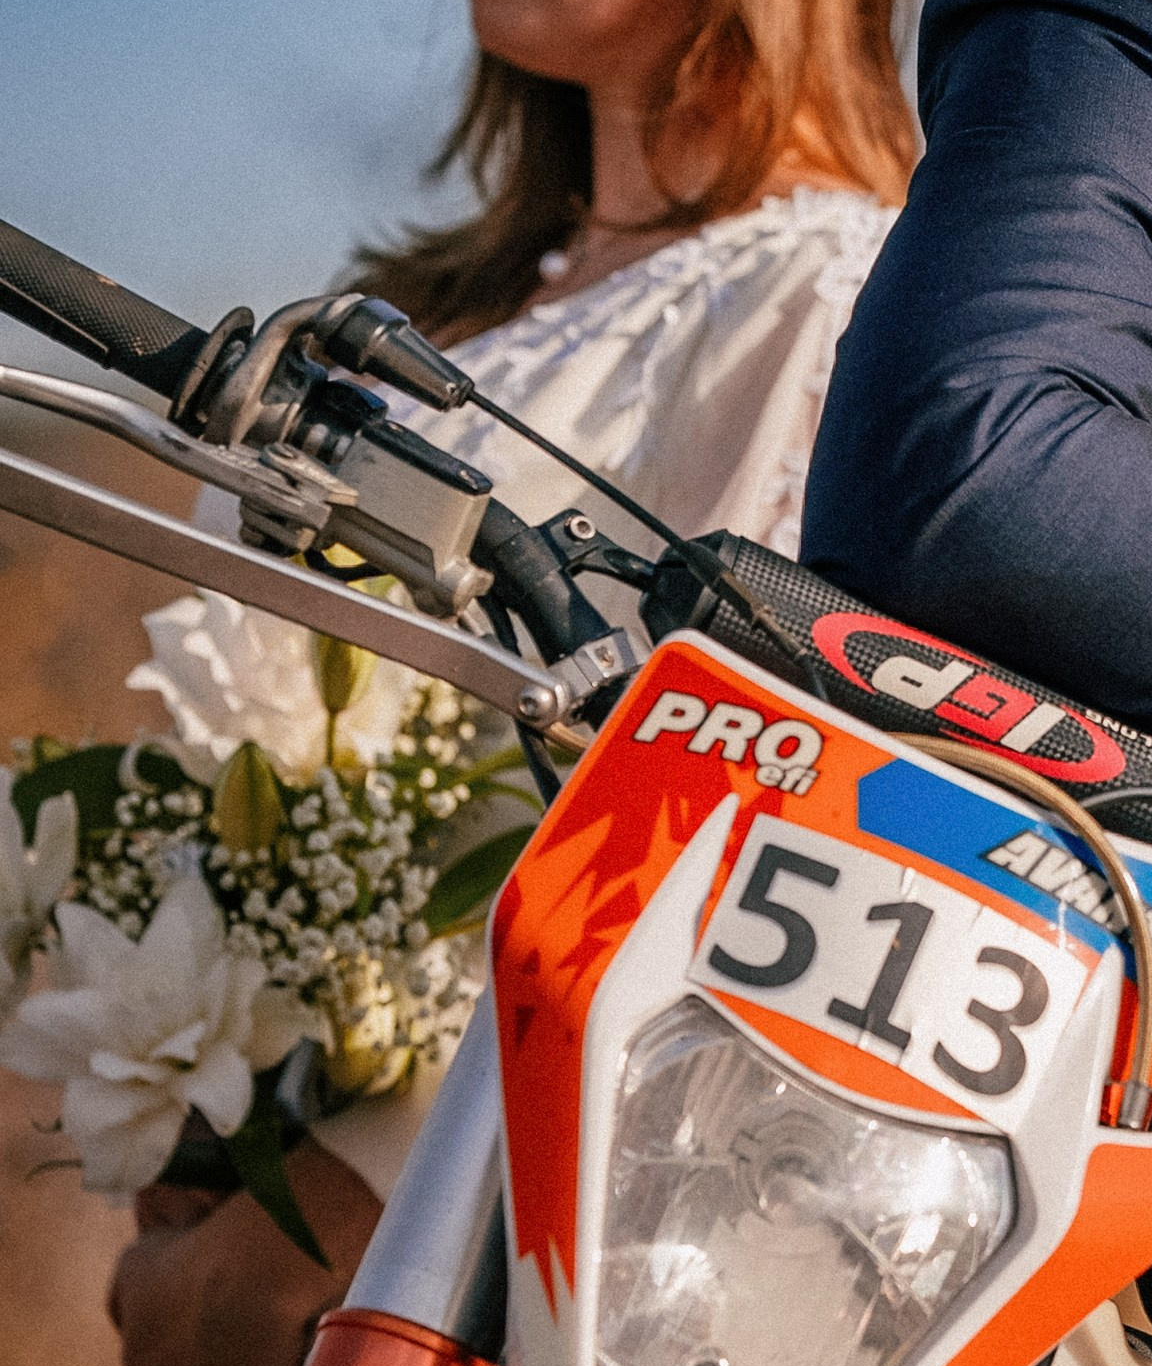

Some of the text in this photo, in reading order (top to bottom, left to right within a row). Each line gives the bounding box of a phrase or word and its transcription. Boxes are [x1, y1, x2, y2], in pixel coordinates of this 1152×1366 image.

[635, 691, 824, 767] PRO
[871, 654, 1067, 755] IGP
[756, 759, 819, 796] efi
[707, 843, 1051, 1097] 513
